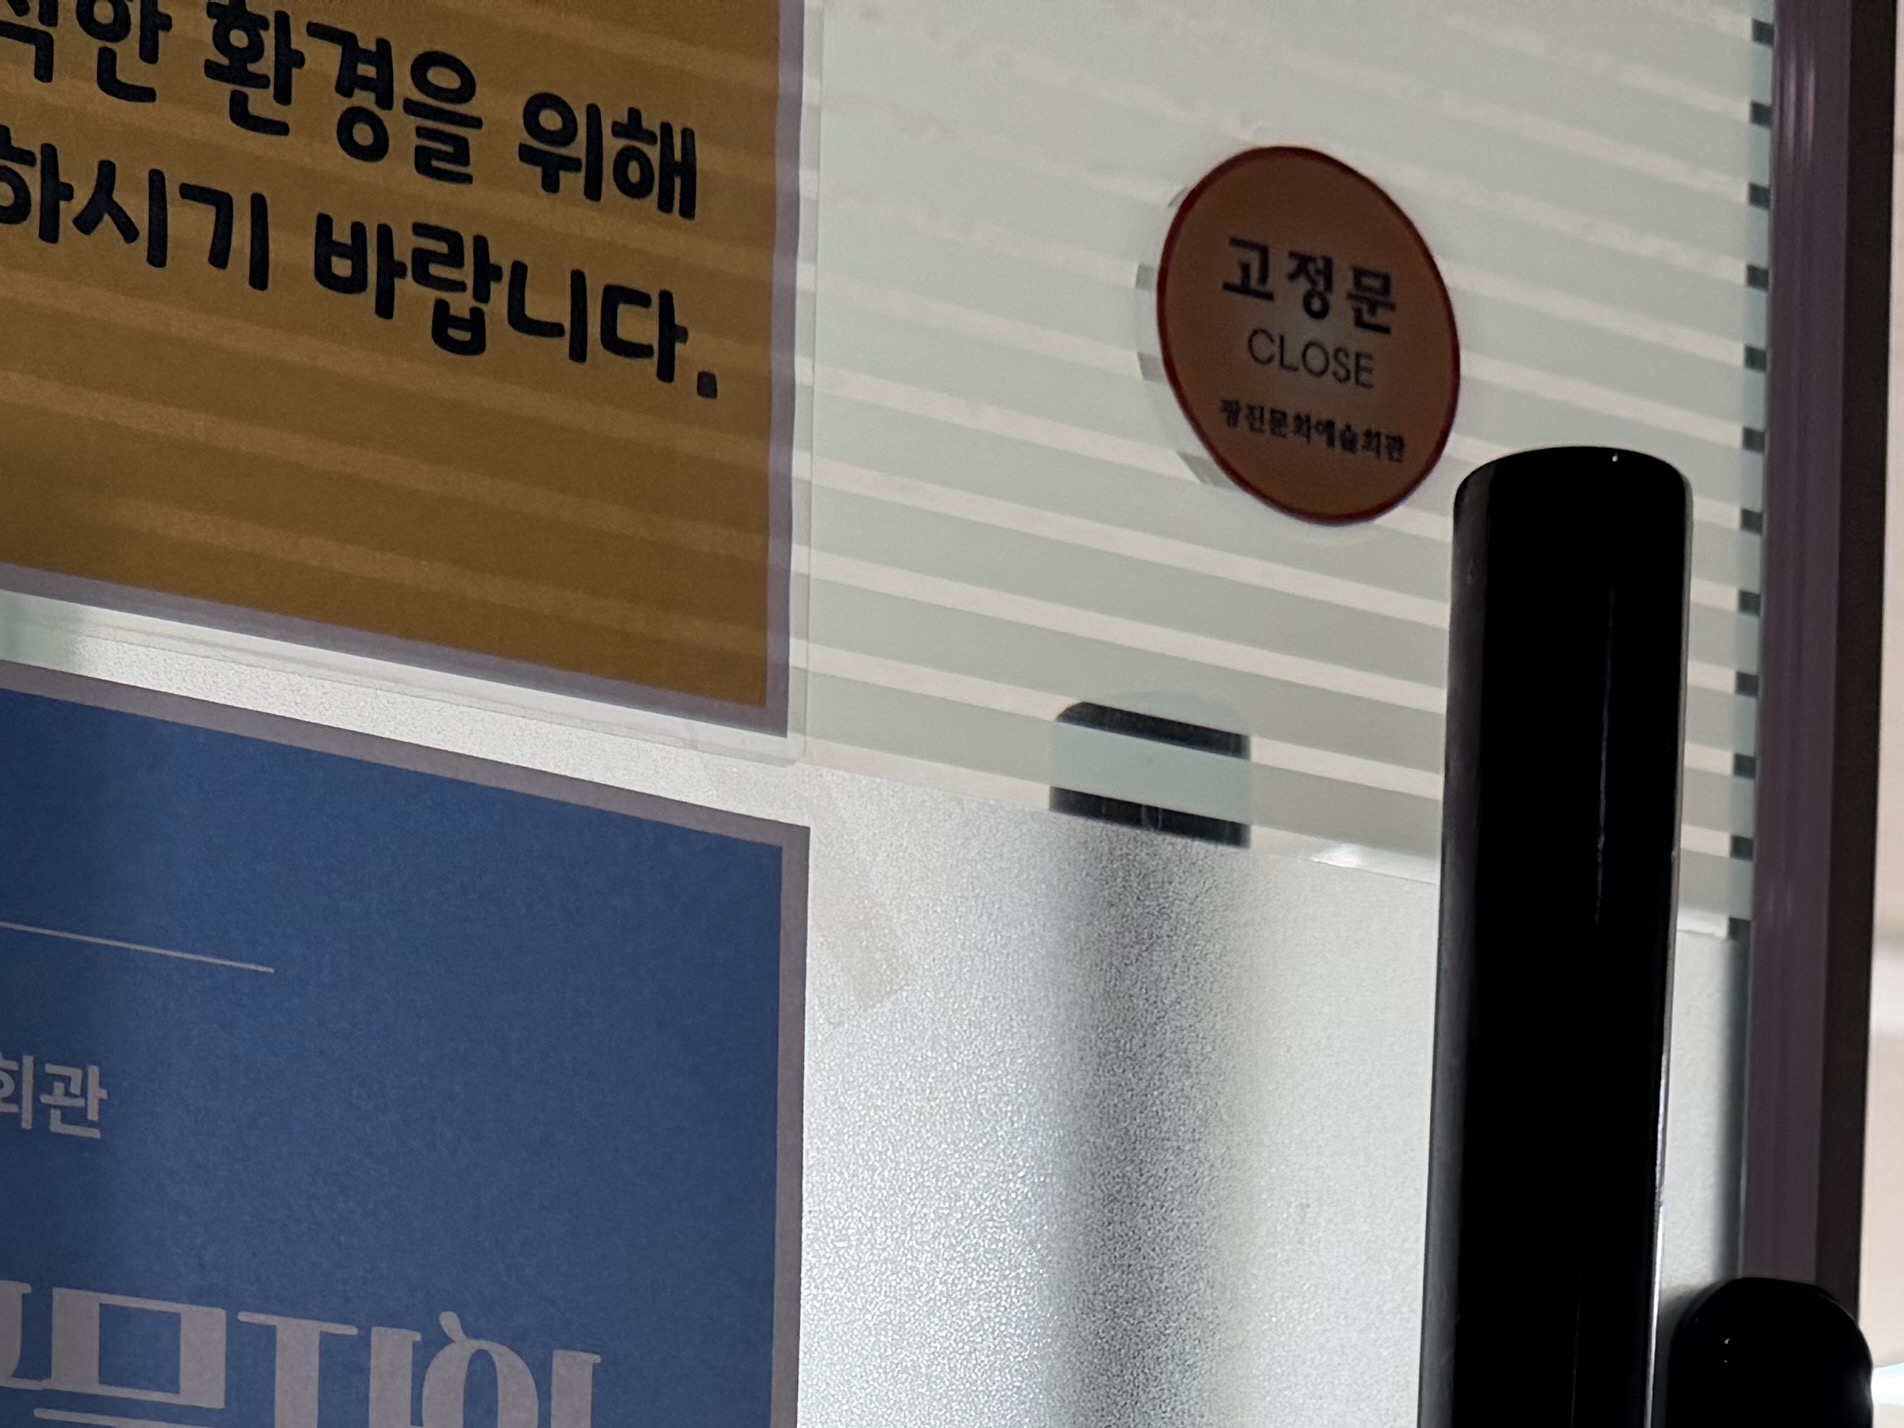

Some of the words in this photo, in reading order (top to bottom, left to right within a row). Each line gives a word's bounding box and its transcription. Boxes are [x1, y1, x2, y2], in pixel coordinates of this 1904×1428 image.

[203, 0, 484, 186] 환경을
[518, 92, 698, 220] 위해
[313, 213, 720, 400] 바랍니다.
[1221, 235, 1397, 335] 고정문
[1247, 328, 1375, 390] CLOSE
[1218, 398, 1406, 463] 광진문화예술회관
